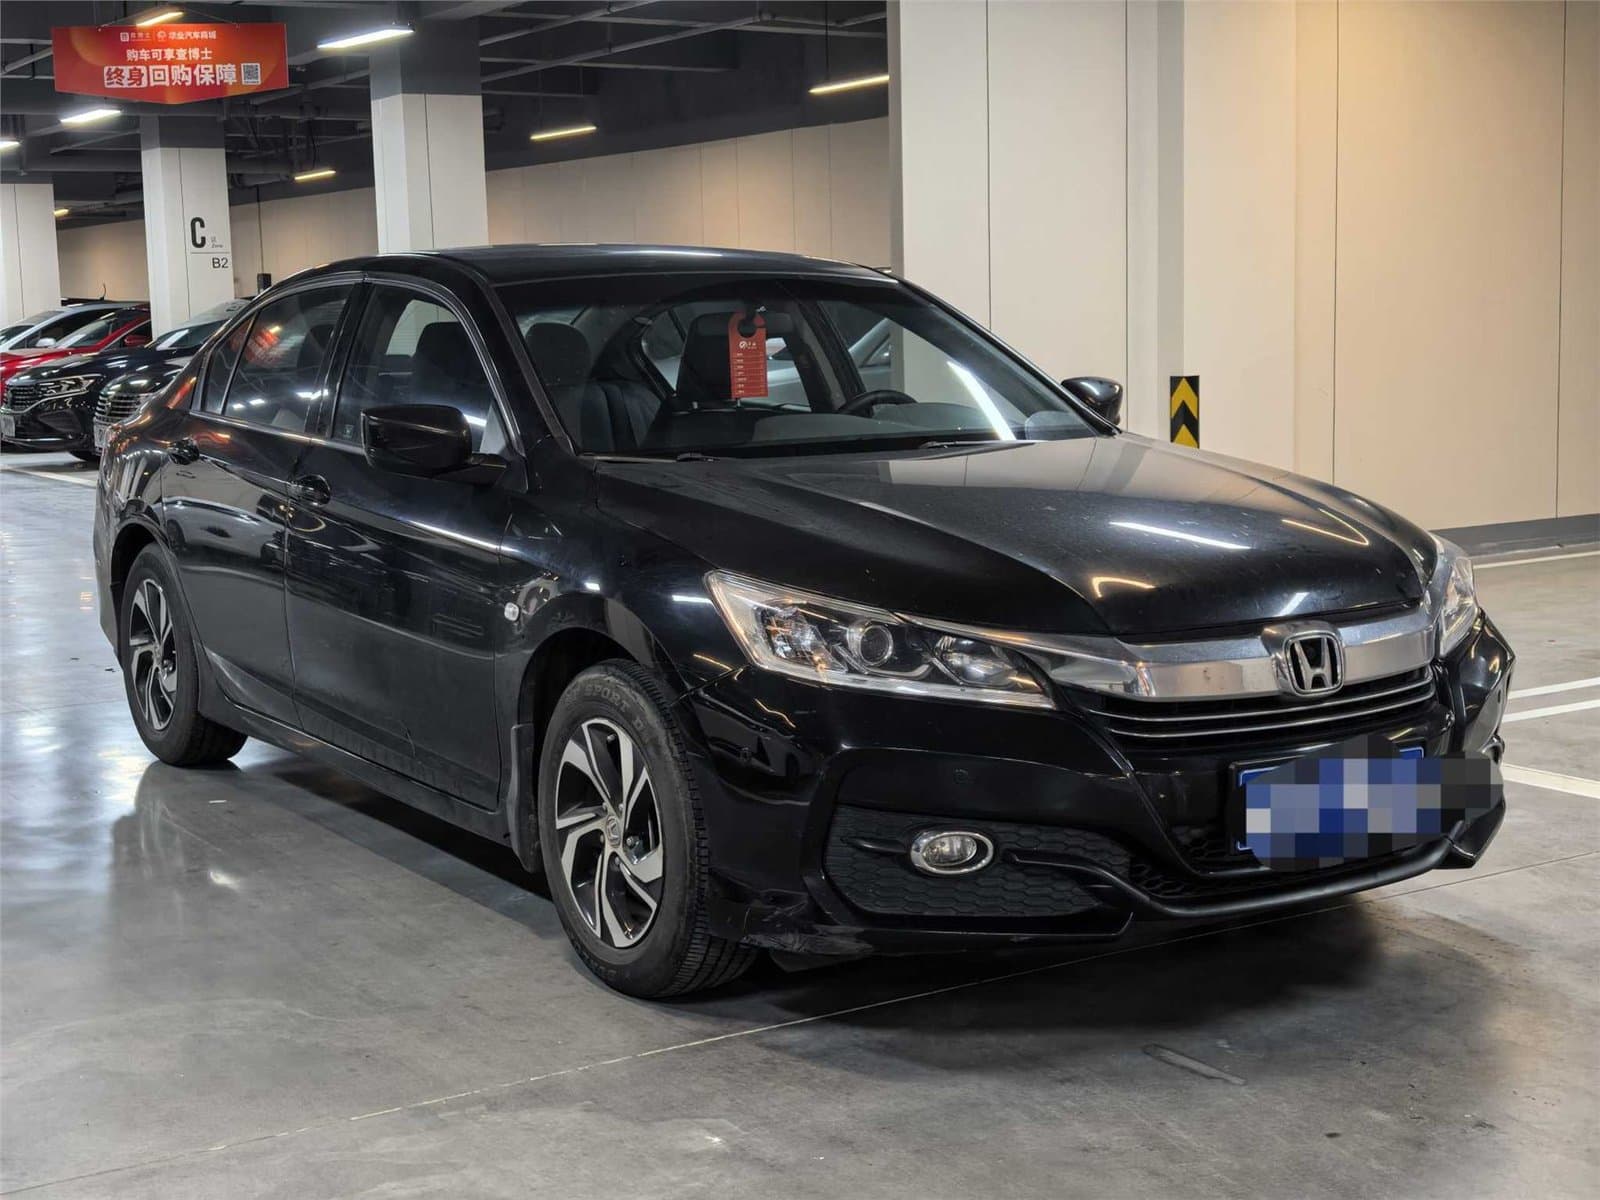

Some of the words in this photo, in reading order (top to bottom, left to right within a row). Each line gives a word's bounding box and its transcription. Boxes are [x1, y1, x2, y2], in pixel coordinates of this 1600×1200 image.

[126, 47, 213, 61] 购车可享查博士
[105, 63, 237, 87] 终身回购保障
[190, 216, 206, 248] C
[212, 257, 229, 268] B2
[584, 683, 631, 713] SPORT
